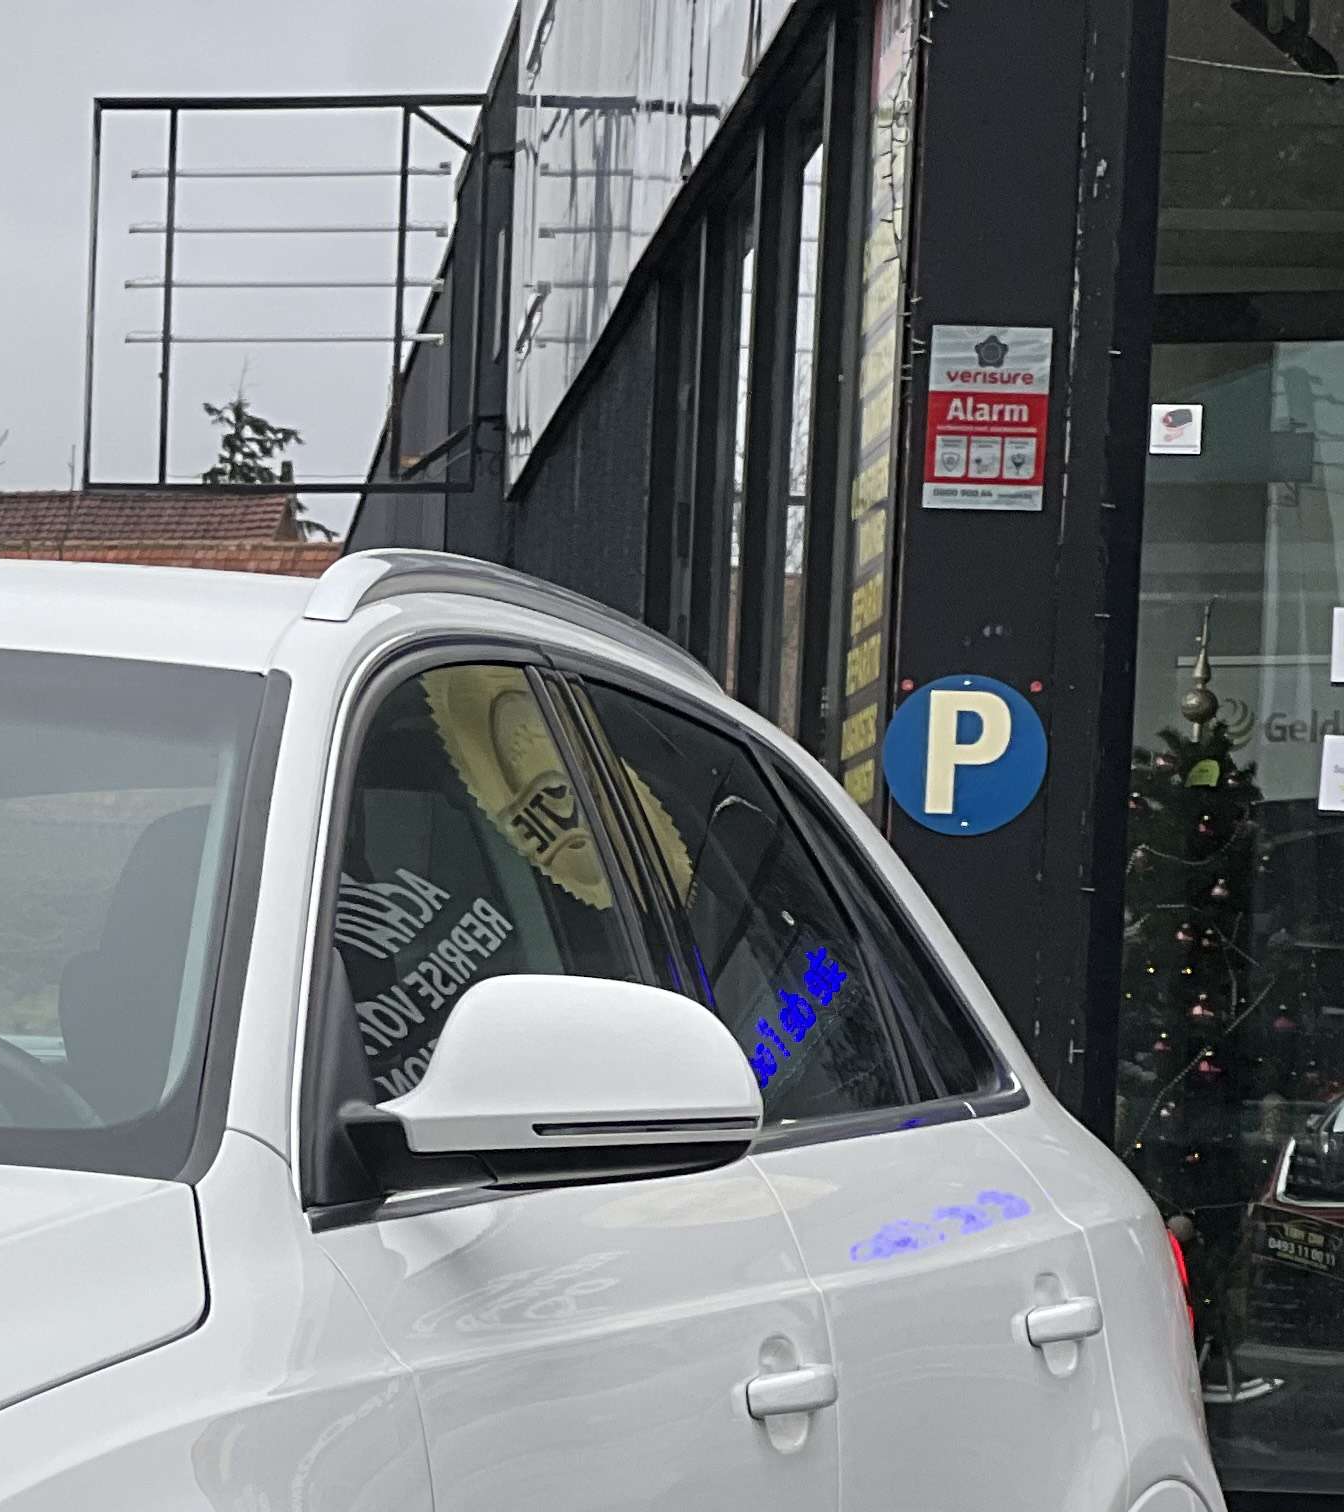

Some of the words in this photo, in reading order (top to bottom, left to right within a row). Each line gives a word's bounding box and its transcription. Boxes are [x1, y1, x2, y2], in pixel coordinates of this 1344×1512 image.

[946, 369, 1035, 385] verisure
[946, 396, 1029, 422] Alarm
[924, 688, 1012, 814] P
